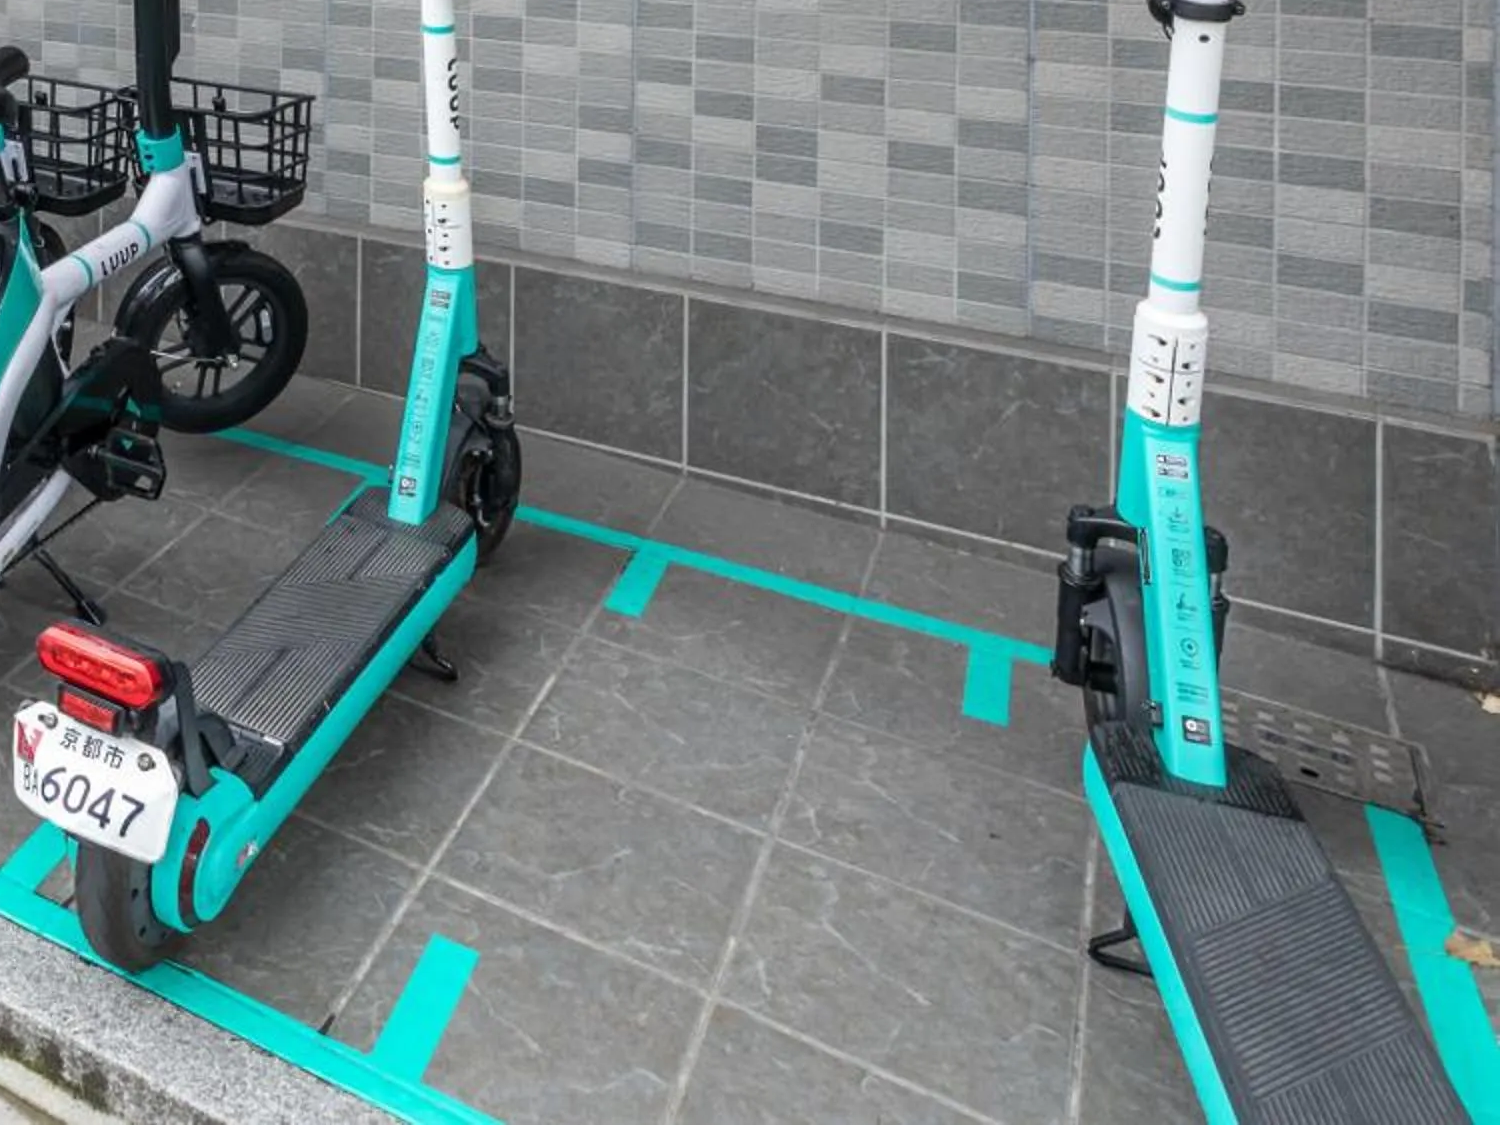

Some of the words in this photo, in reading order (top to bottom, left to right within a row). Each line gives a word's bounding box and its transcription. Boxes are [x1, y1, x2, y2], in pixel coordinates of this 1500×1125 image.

[101, 242, 139, 276] LUUP
[59, 726, 125, 770] 京都市
[40, 766, 146, 838] 6047
